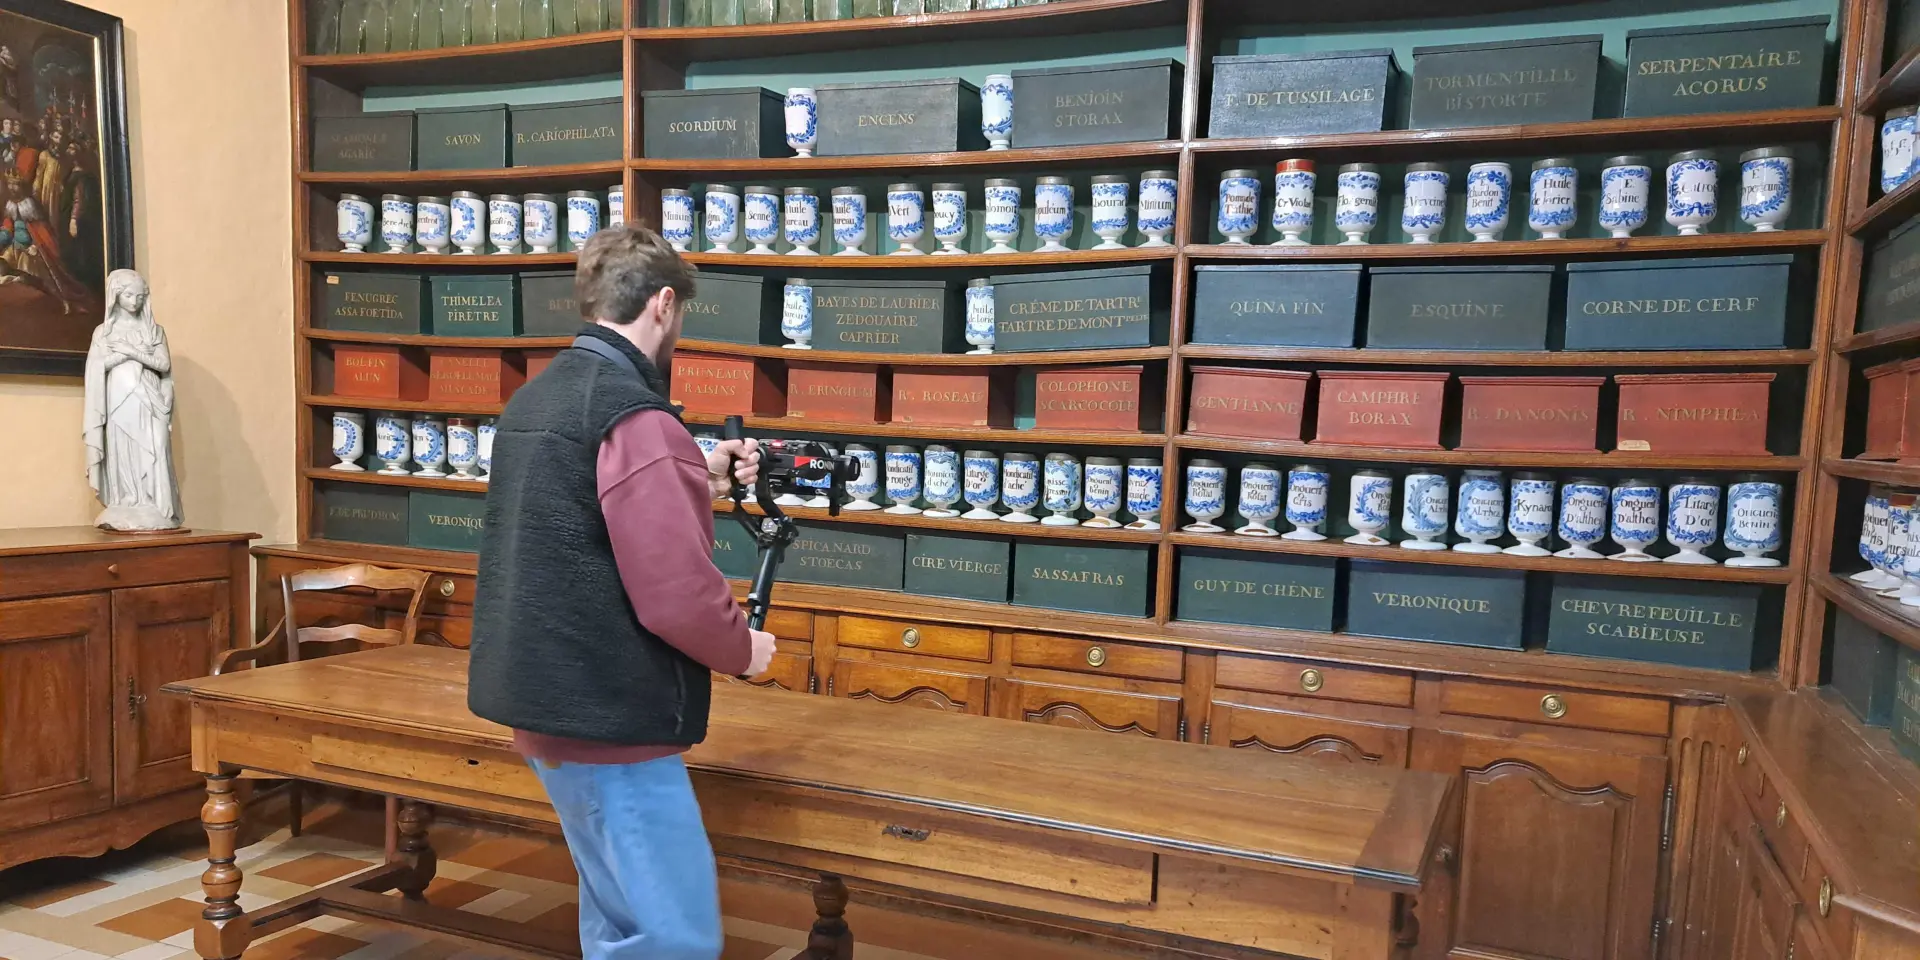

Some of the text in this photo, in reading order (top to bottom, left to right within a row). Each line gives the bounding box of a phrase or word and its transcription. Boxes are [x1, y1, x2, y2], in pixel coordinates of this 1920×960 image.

[1638, 49, 1801, 76] SERPENTAIRE
[1425, 66, 1577, 92] TORMENTILLE
[1673, 77, 1768, 96] ACORUS
[1247, 93, 1268, 106] DE
[1272, 85, 1376, 105] TUSSILAGE
[1446, 92, 1550, 112] BISTORTE
[669, 117, 737, 133] SCORDIUM
[858, 113, 916, 127] ENCENS
[1055, 112, 1124, 127] STORAX
[445, 134, 482, 146] SAVON
[345, 292, 398, 304] FENUGREC
[441, 293, 502, 306] THIMELEA
[816, 294, 940, 310] BAYES DE LAURIER
[1064, 299, 1084, 313] DE
[1582, 296, 1760, 315] CORNE DE CERF
[335, 307, 403, 319] ASSA FOETIDA
[1230, 299, 1326, 316] QUINA FIN
[1410, 300, 1507, 319] ESQUINE
[836, 312, 918, 327] ZEDOUAIRE
[998, 319, 1056, 333] TARTRE
[1057, 318, 1078, 331] DE
[840, 330, 900, 344] CAPRIER
[684, 383, 736, 397] RAISINS
[1040, 380, 1133, 393] COLOPHONE
[923, 390, 983, 403] ROSEAU
[1196, 395, 1298, 415] GENTIANNE
[1656, 403, 1760, 421] NIMPHEA
[1349, 412, 1413, 426] BORAX
[428, 512, 484, 530] VERONIQU
[1685, 514, 1712, 527] D'or
[792, 537, 871, 556] SPICA NARD
[912, 553, 1002, 574] CIRE VIERGE
[1032, 567, 1125, 587] SASSAFRAS
[1193, 579, 1232, 592] GUY
[1234, 581, 1257, 594] DE
[1373, 592, 1491, 614] VERONIQUE
[1560, 599, 1743, 628] CHEVREFEUILLE
[1586, 622, 1706, 645] SCABIEUSE
